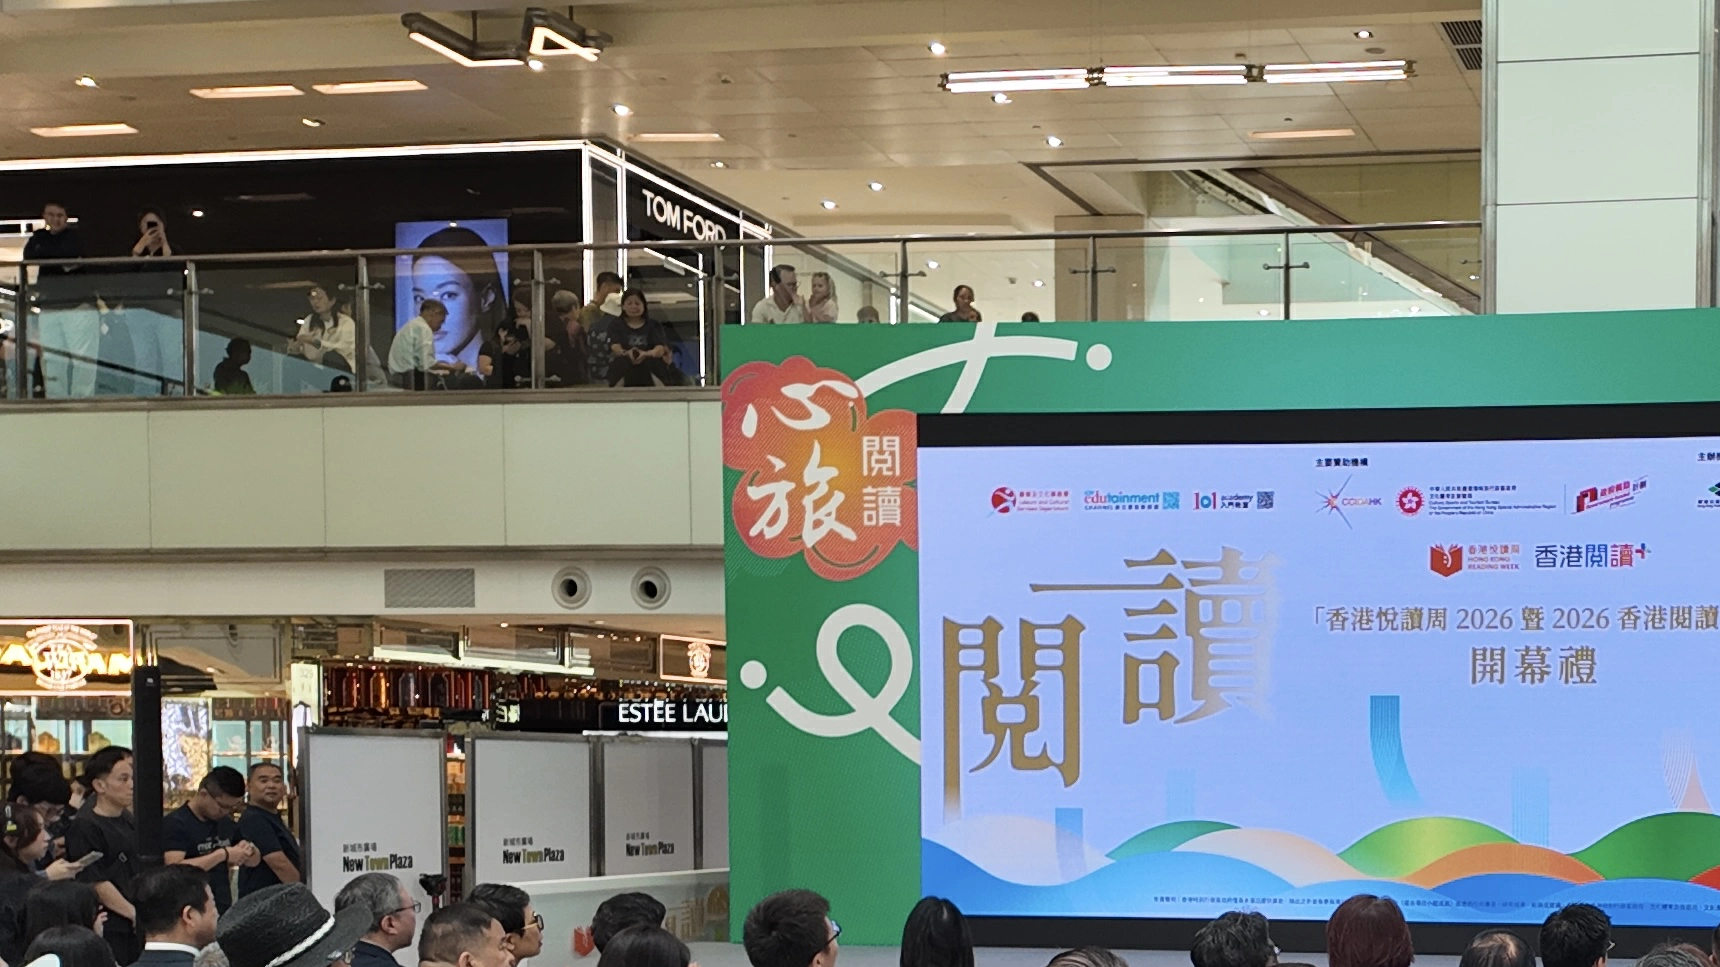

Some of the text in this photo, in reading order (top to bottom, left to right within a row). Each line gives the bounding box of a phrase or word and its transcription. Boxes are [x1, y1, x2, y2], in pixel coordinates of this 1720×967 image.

[641, 188, 727, 242] TOM FORD
[741, 379, 860, 549] 心旅
[861, 434, 902, 528] 閱讀
[1084, 490, 1160, 504] edutainment
[1456, 607, 1514, 630] 2026
[1519, 606, 1546, 632] 暨
[1551, 607, 1610, 630] 2026
[1470, 645, 1598, 686] 開幕禮
[502, 847, 565, 864] New Town Plaza
[625, 841, 675, 857] New Town Plaza
[343, 853, 413, 873] New Town Plaza
